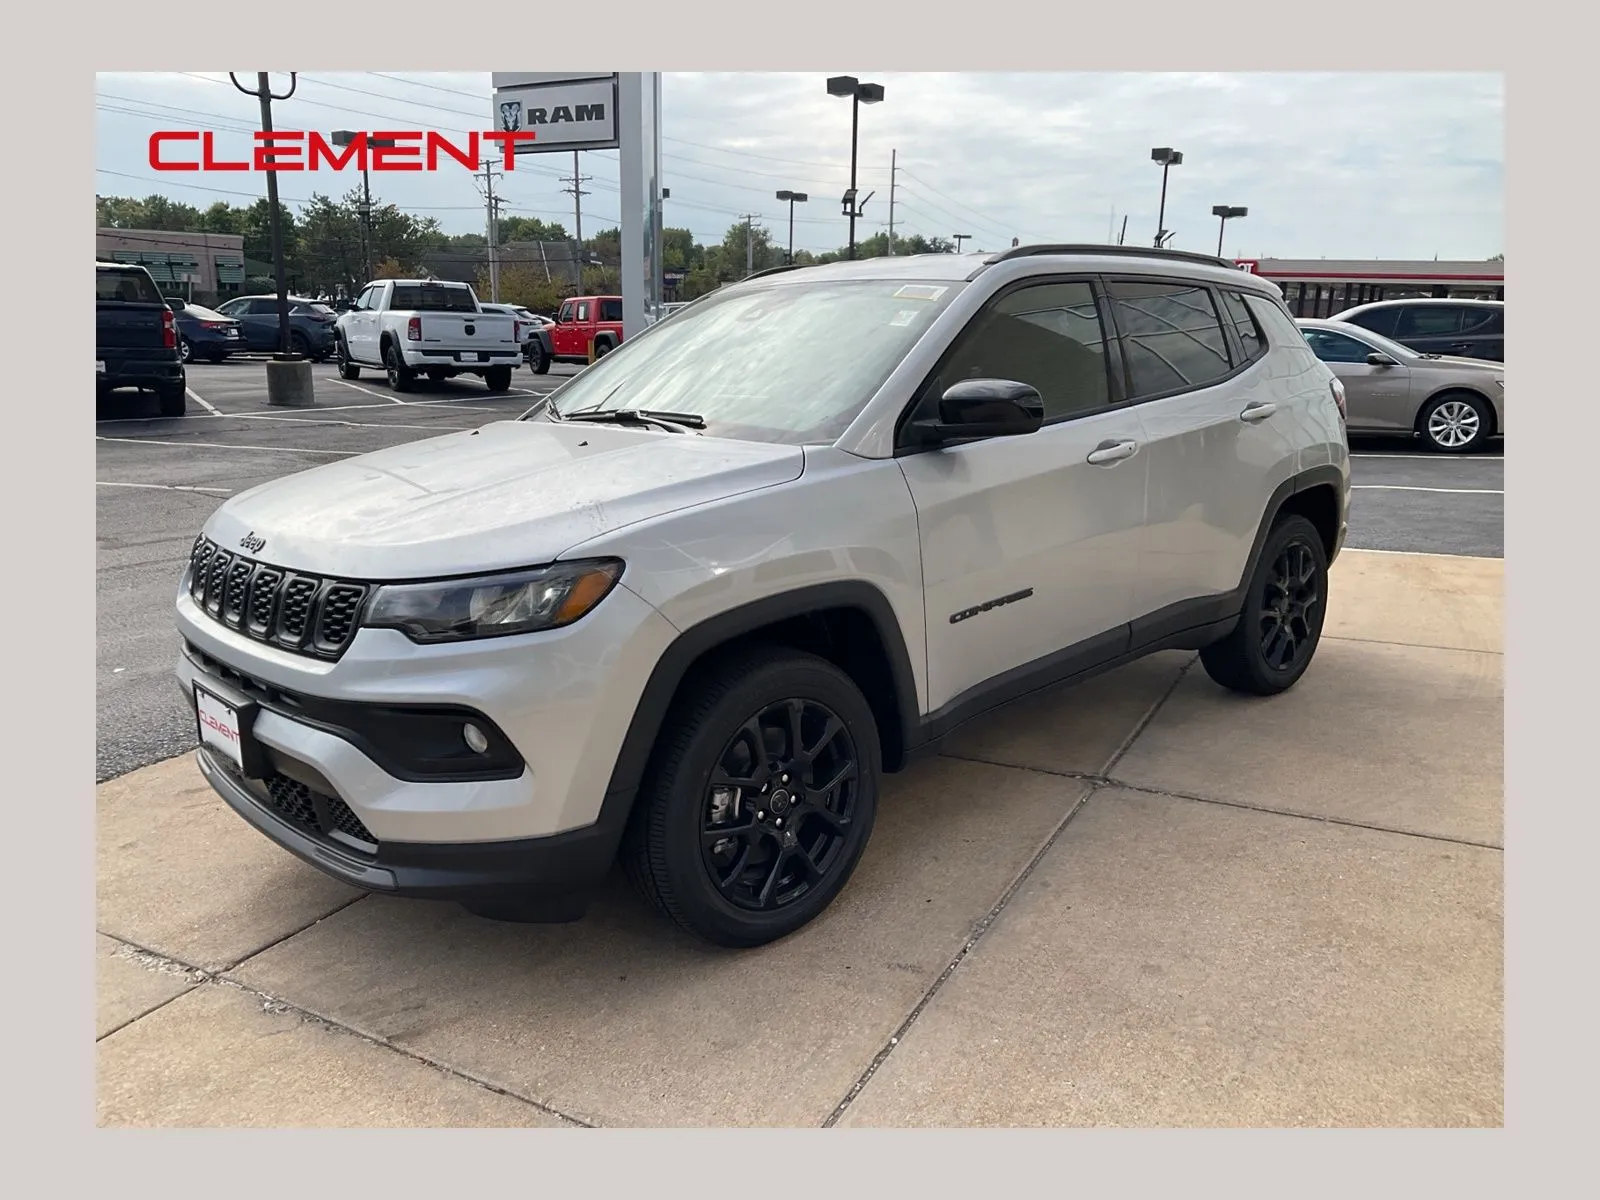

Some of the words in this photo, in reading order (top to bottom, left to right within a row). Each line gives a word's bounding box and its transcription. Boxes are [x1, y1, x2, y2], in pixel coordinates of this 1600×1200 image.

[527, 103, 605, 125] RAM
[240, 531, 267, 554] Jeep
[949, 587, 1034, 625] COMPASS
[199, 709, 240, 745] CLEMENT
